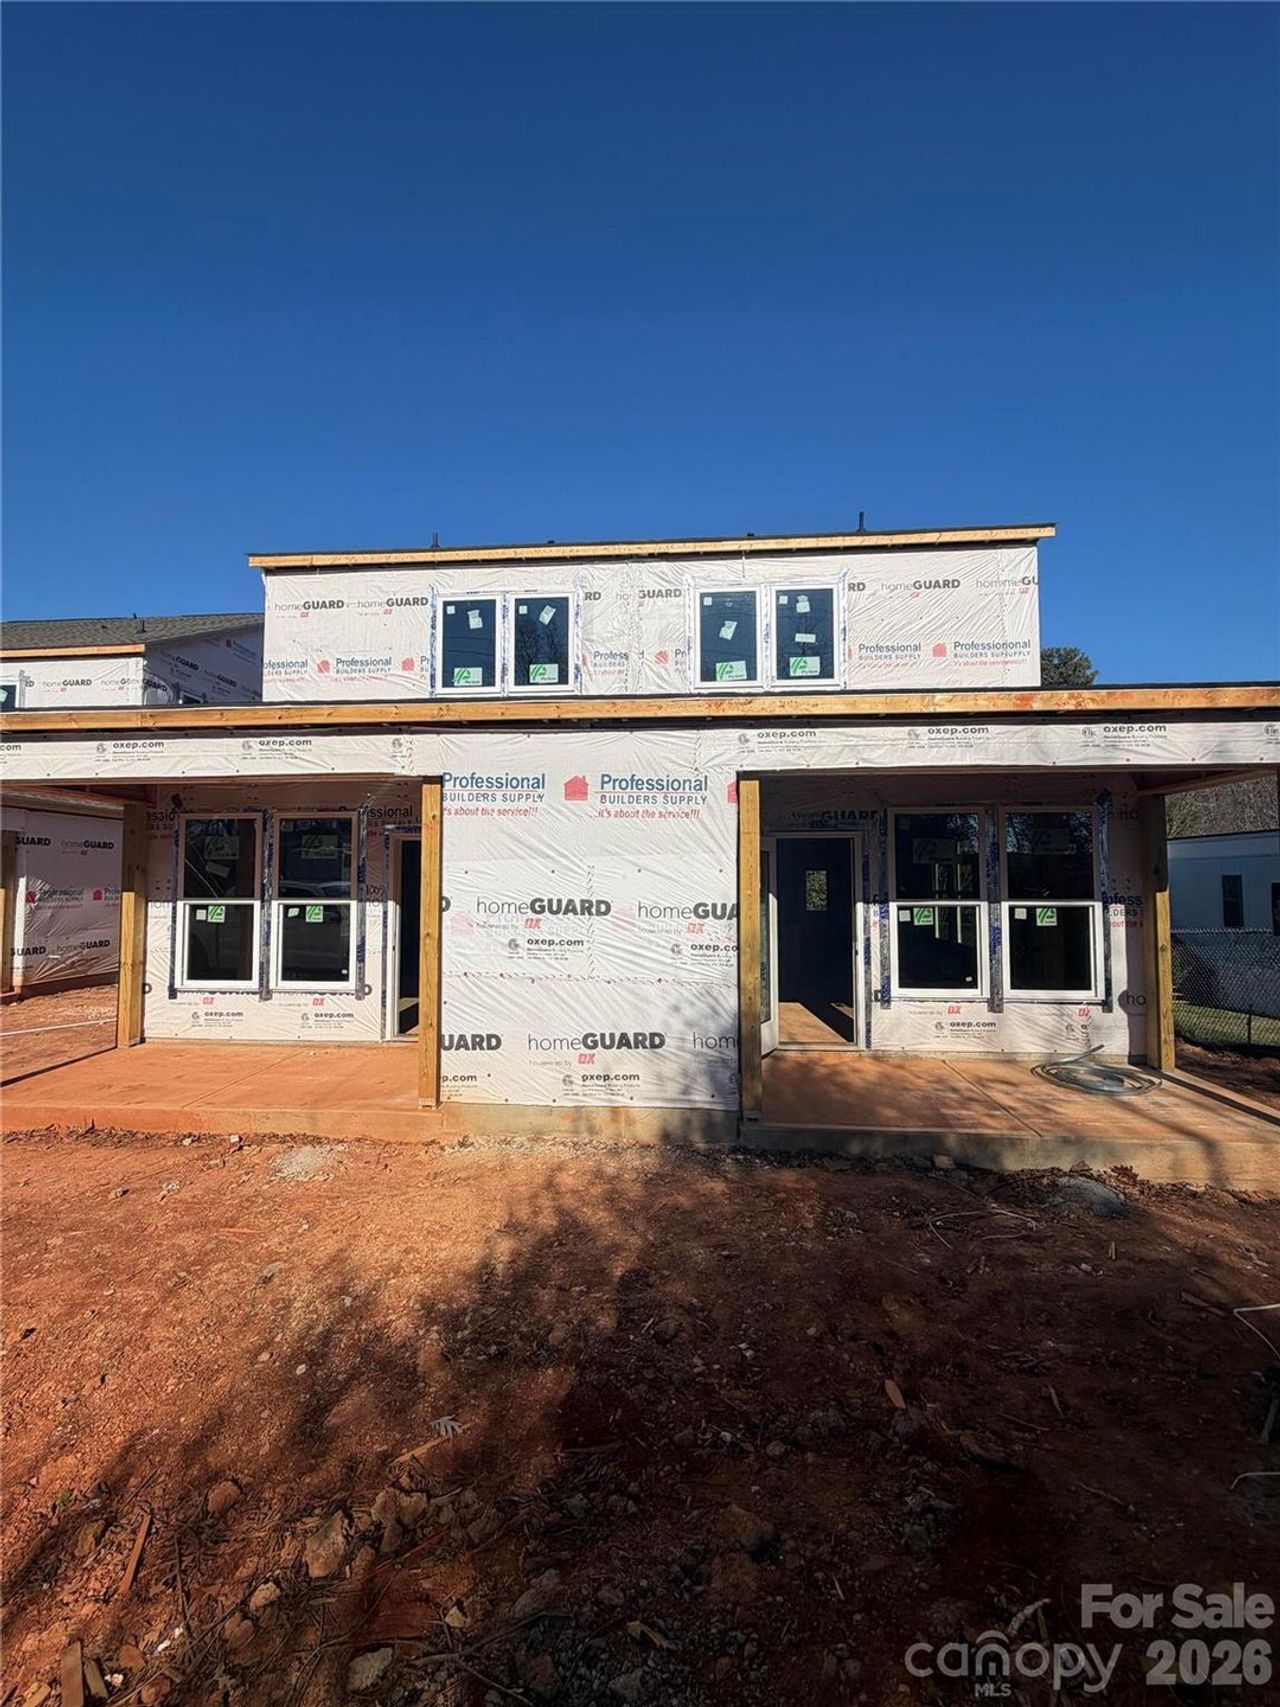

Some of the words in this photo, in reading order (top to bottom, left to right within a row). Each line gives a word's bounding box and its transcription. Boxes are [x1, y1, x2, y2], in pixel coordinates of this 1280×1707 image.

[880, 579, 961, 591] homeGUARD
[274, 599, 345, 612] homeGUARD
[357, 596, 429, 608] homeGUARD
[858, 641, 921, 653] Professional
[335, 656, 392, 667] Professional
[757, 729, 817, 739] oxep.com
[927, 726, 989, 736] oxep.com
[1103, 723, 1167, 734] oxep.com
[112, 741, 165, 750] oxep.com
[258, 738, 312, 747] oxep.com
[442, 772, 546, 790] Professional
[600, 773, 708, 792] Professional
[442, 792, 497, 803] BUILDERS
[501, 792, 545, 803] SUPPLY
[600, 794, 658, 805] BUILDERS
[662, 794, 708, 805] SUPPLY
[454, 806, 479, 817] about
[613, 808, 640, 818] about
[61, 839, 115, 850] homeGUARD
[476, 896, 612, 917] homeGUARD
[527, 938, 584, 948] oxep.com
[204, 1011, 244, 1019] oxep.com
[314, 1012, 354, 1020] oxep.com
[949, 1020, 997, 1029] oxep.com
[527, 1032, 666, 1051] homeGUARD
[581, 1073, 640, 1083] oxep.com
